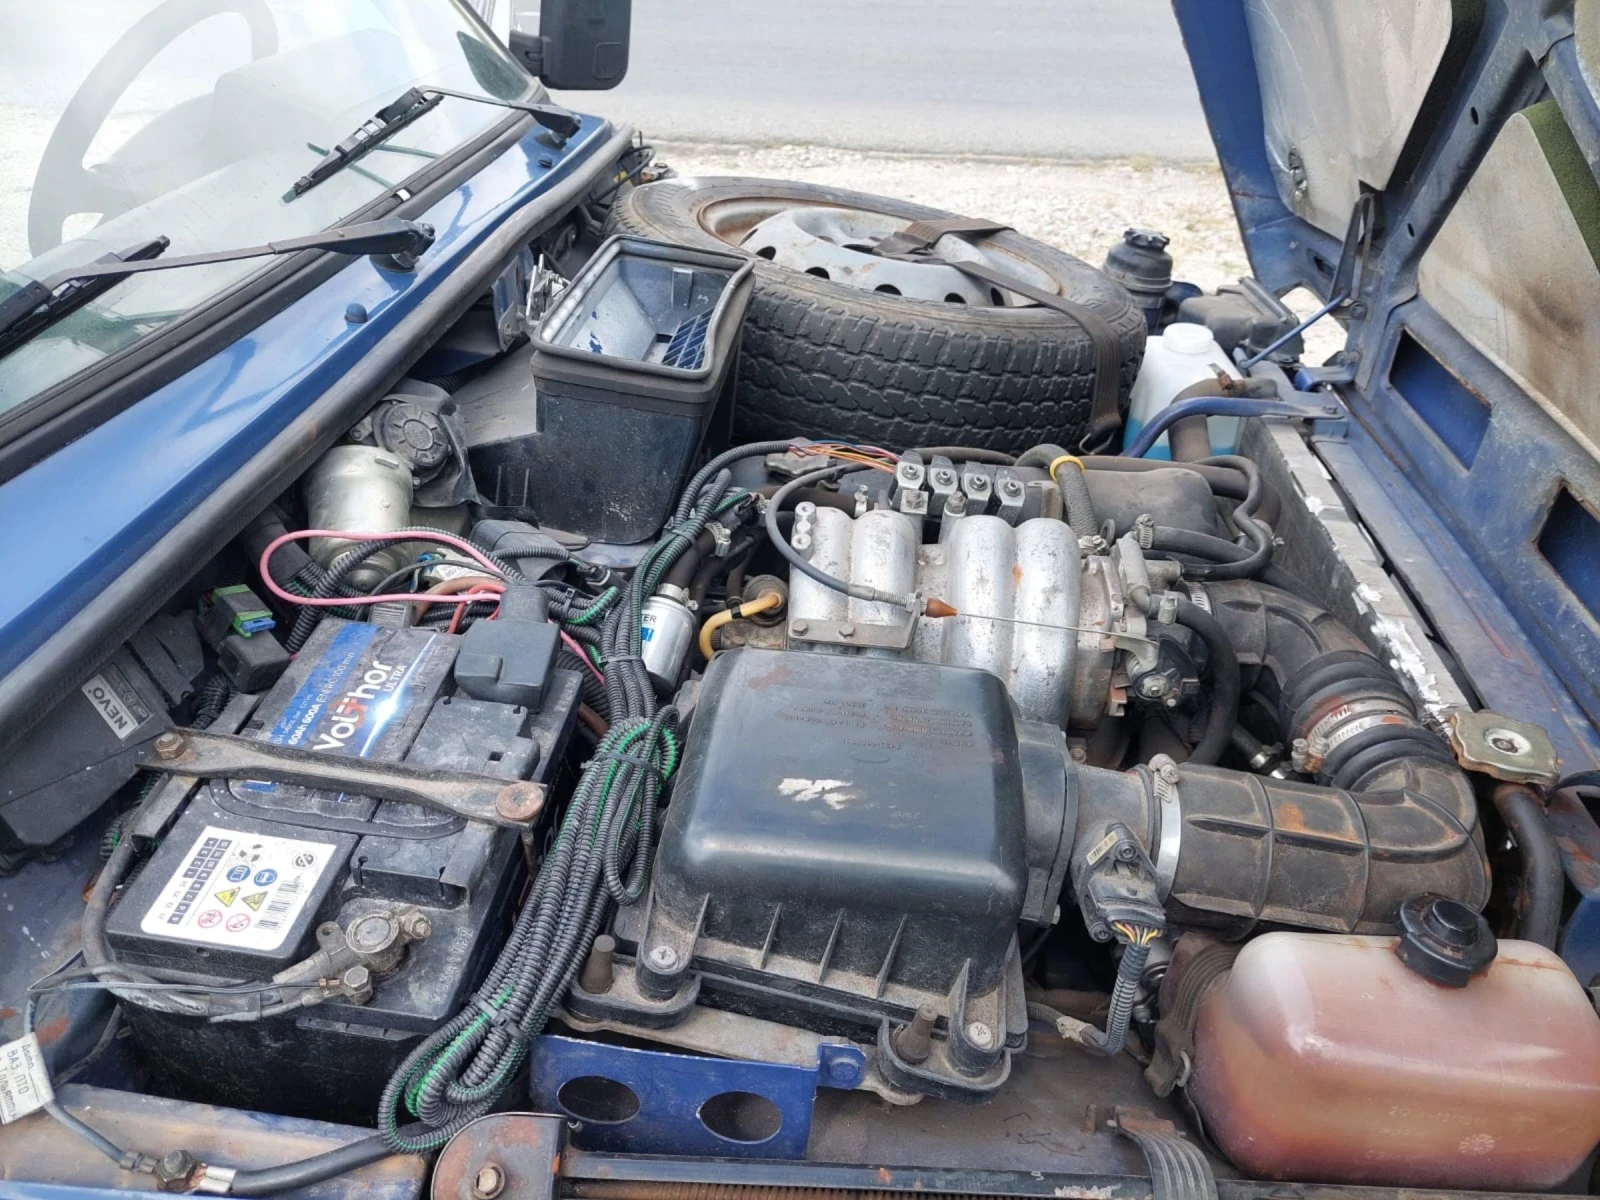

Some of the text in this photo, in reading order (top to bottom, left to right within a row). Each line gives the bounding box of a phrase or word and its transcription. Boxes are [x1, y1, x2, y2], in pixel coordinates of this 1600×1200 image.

[382, 665, 407, 692] ULTRA
[92, 687, 128, 730] NEVO
[288, 722, 307, 745] 60Ah
[303, 703, 322, 723] 600A
